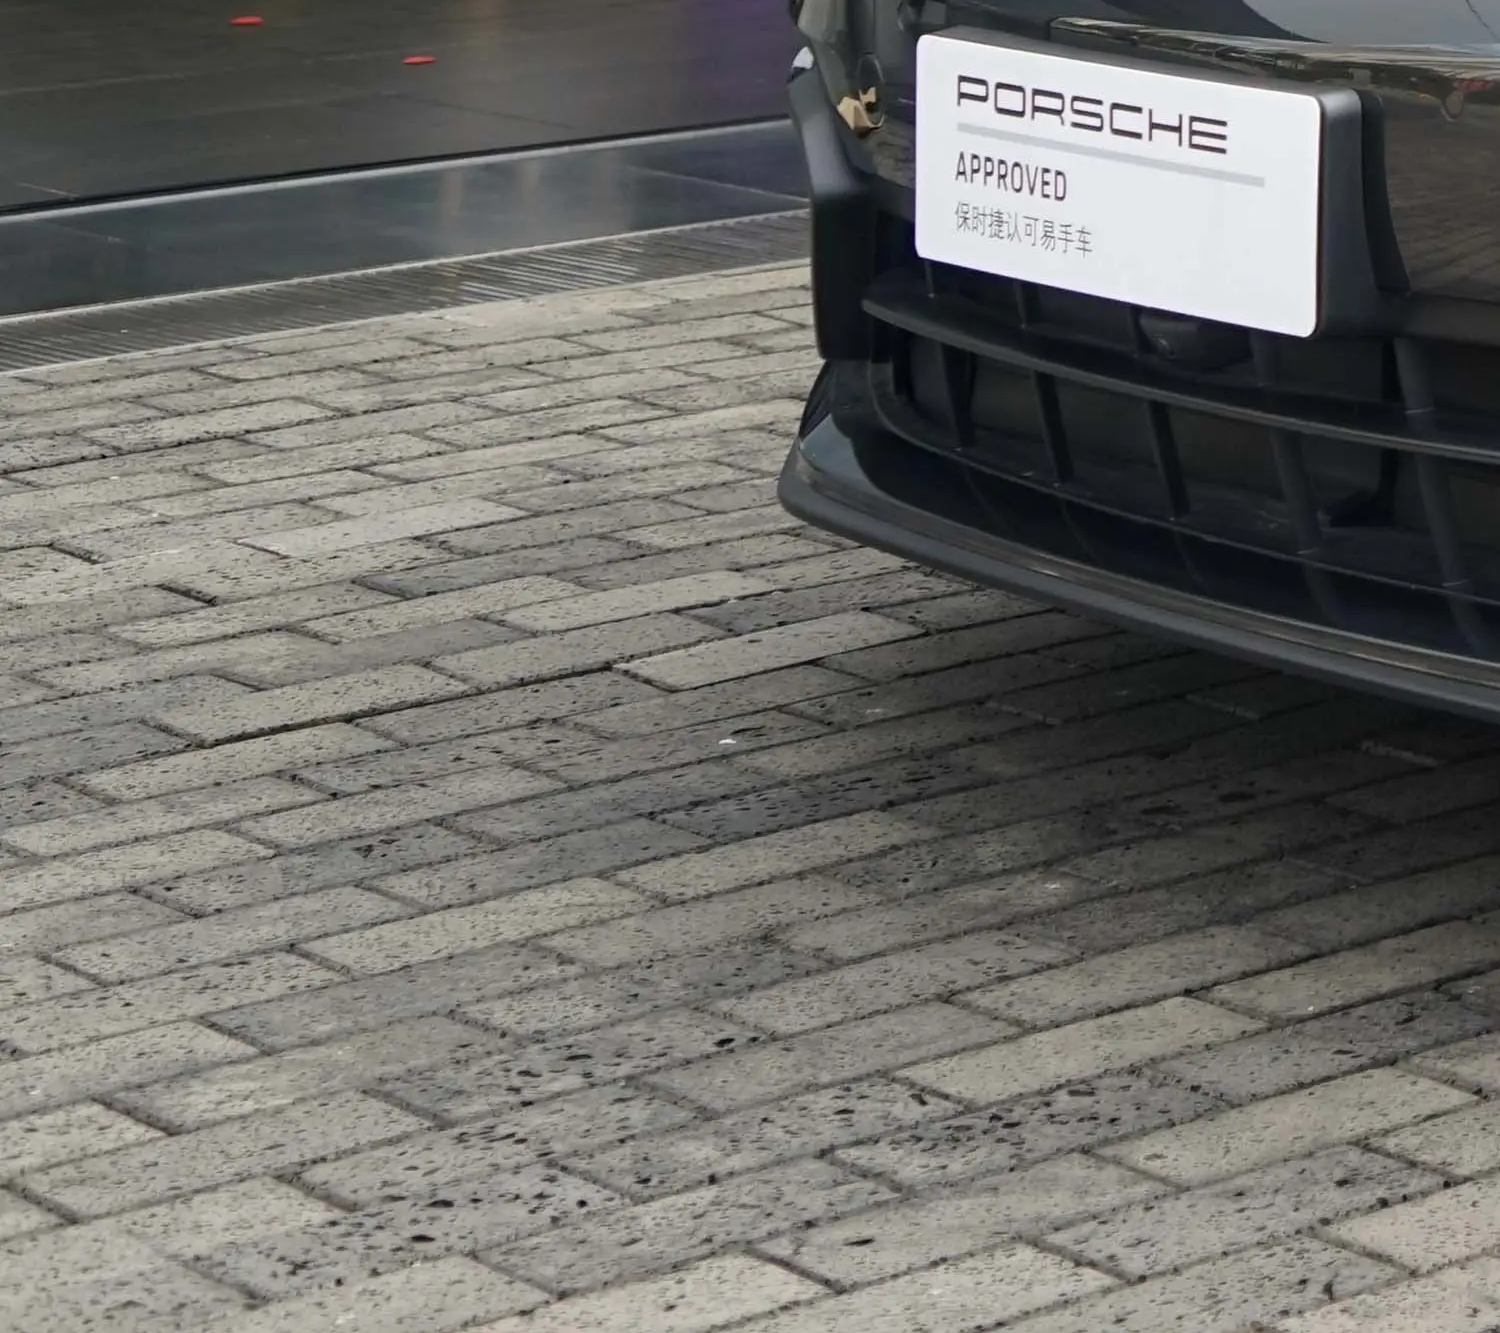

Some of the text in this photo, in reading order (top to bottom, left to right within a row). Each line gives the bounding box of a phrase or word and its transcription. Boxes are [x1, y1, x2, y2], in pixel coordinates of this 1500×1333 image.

[956, 74, 1229, 155] PORSCHE
[954, 151, 1068, 202] APPROVED
[954, 202, 1093, 257] 保时捷认可易手车
